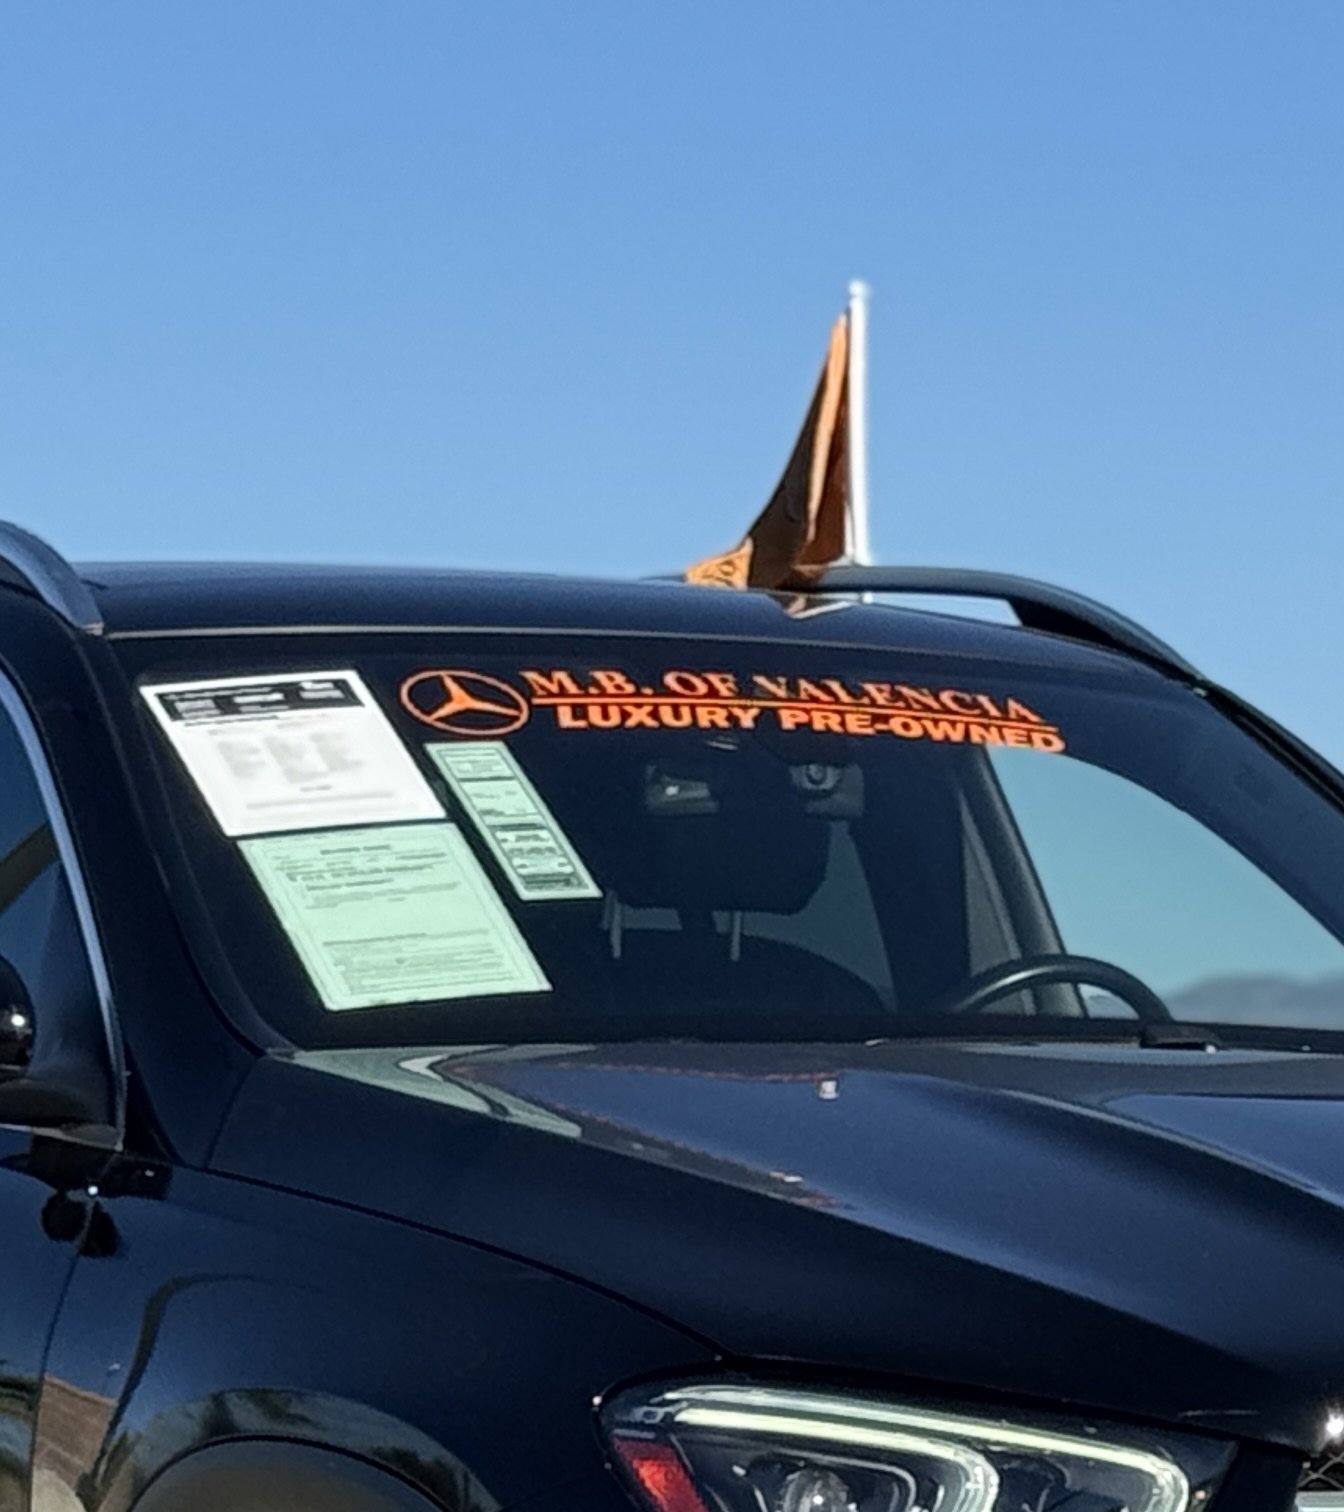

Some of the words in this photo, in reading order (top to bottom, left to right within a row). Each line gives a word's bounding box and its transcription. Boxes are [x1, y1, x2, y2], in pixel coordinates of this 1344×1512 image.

[519, 670, 654, 696] M.B.
[663, 671, 737, 697] OF
[752, 675, 1048, 722] VALENCIA
[557, 705, 762, 729] LUXURY
[778, 708, 1066, 752] PRE-OWNED
